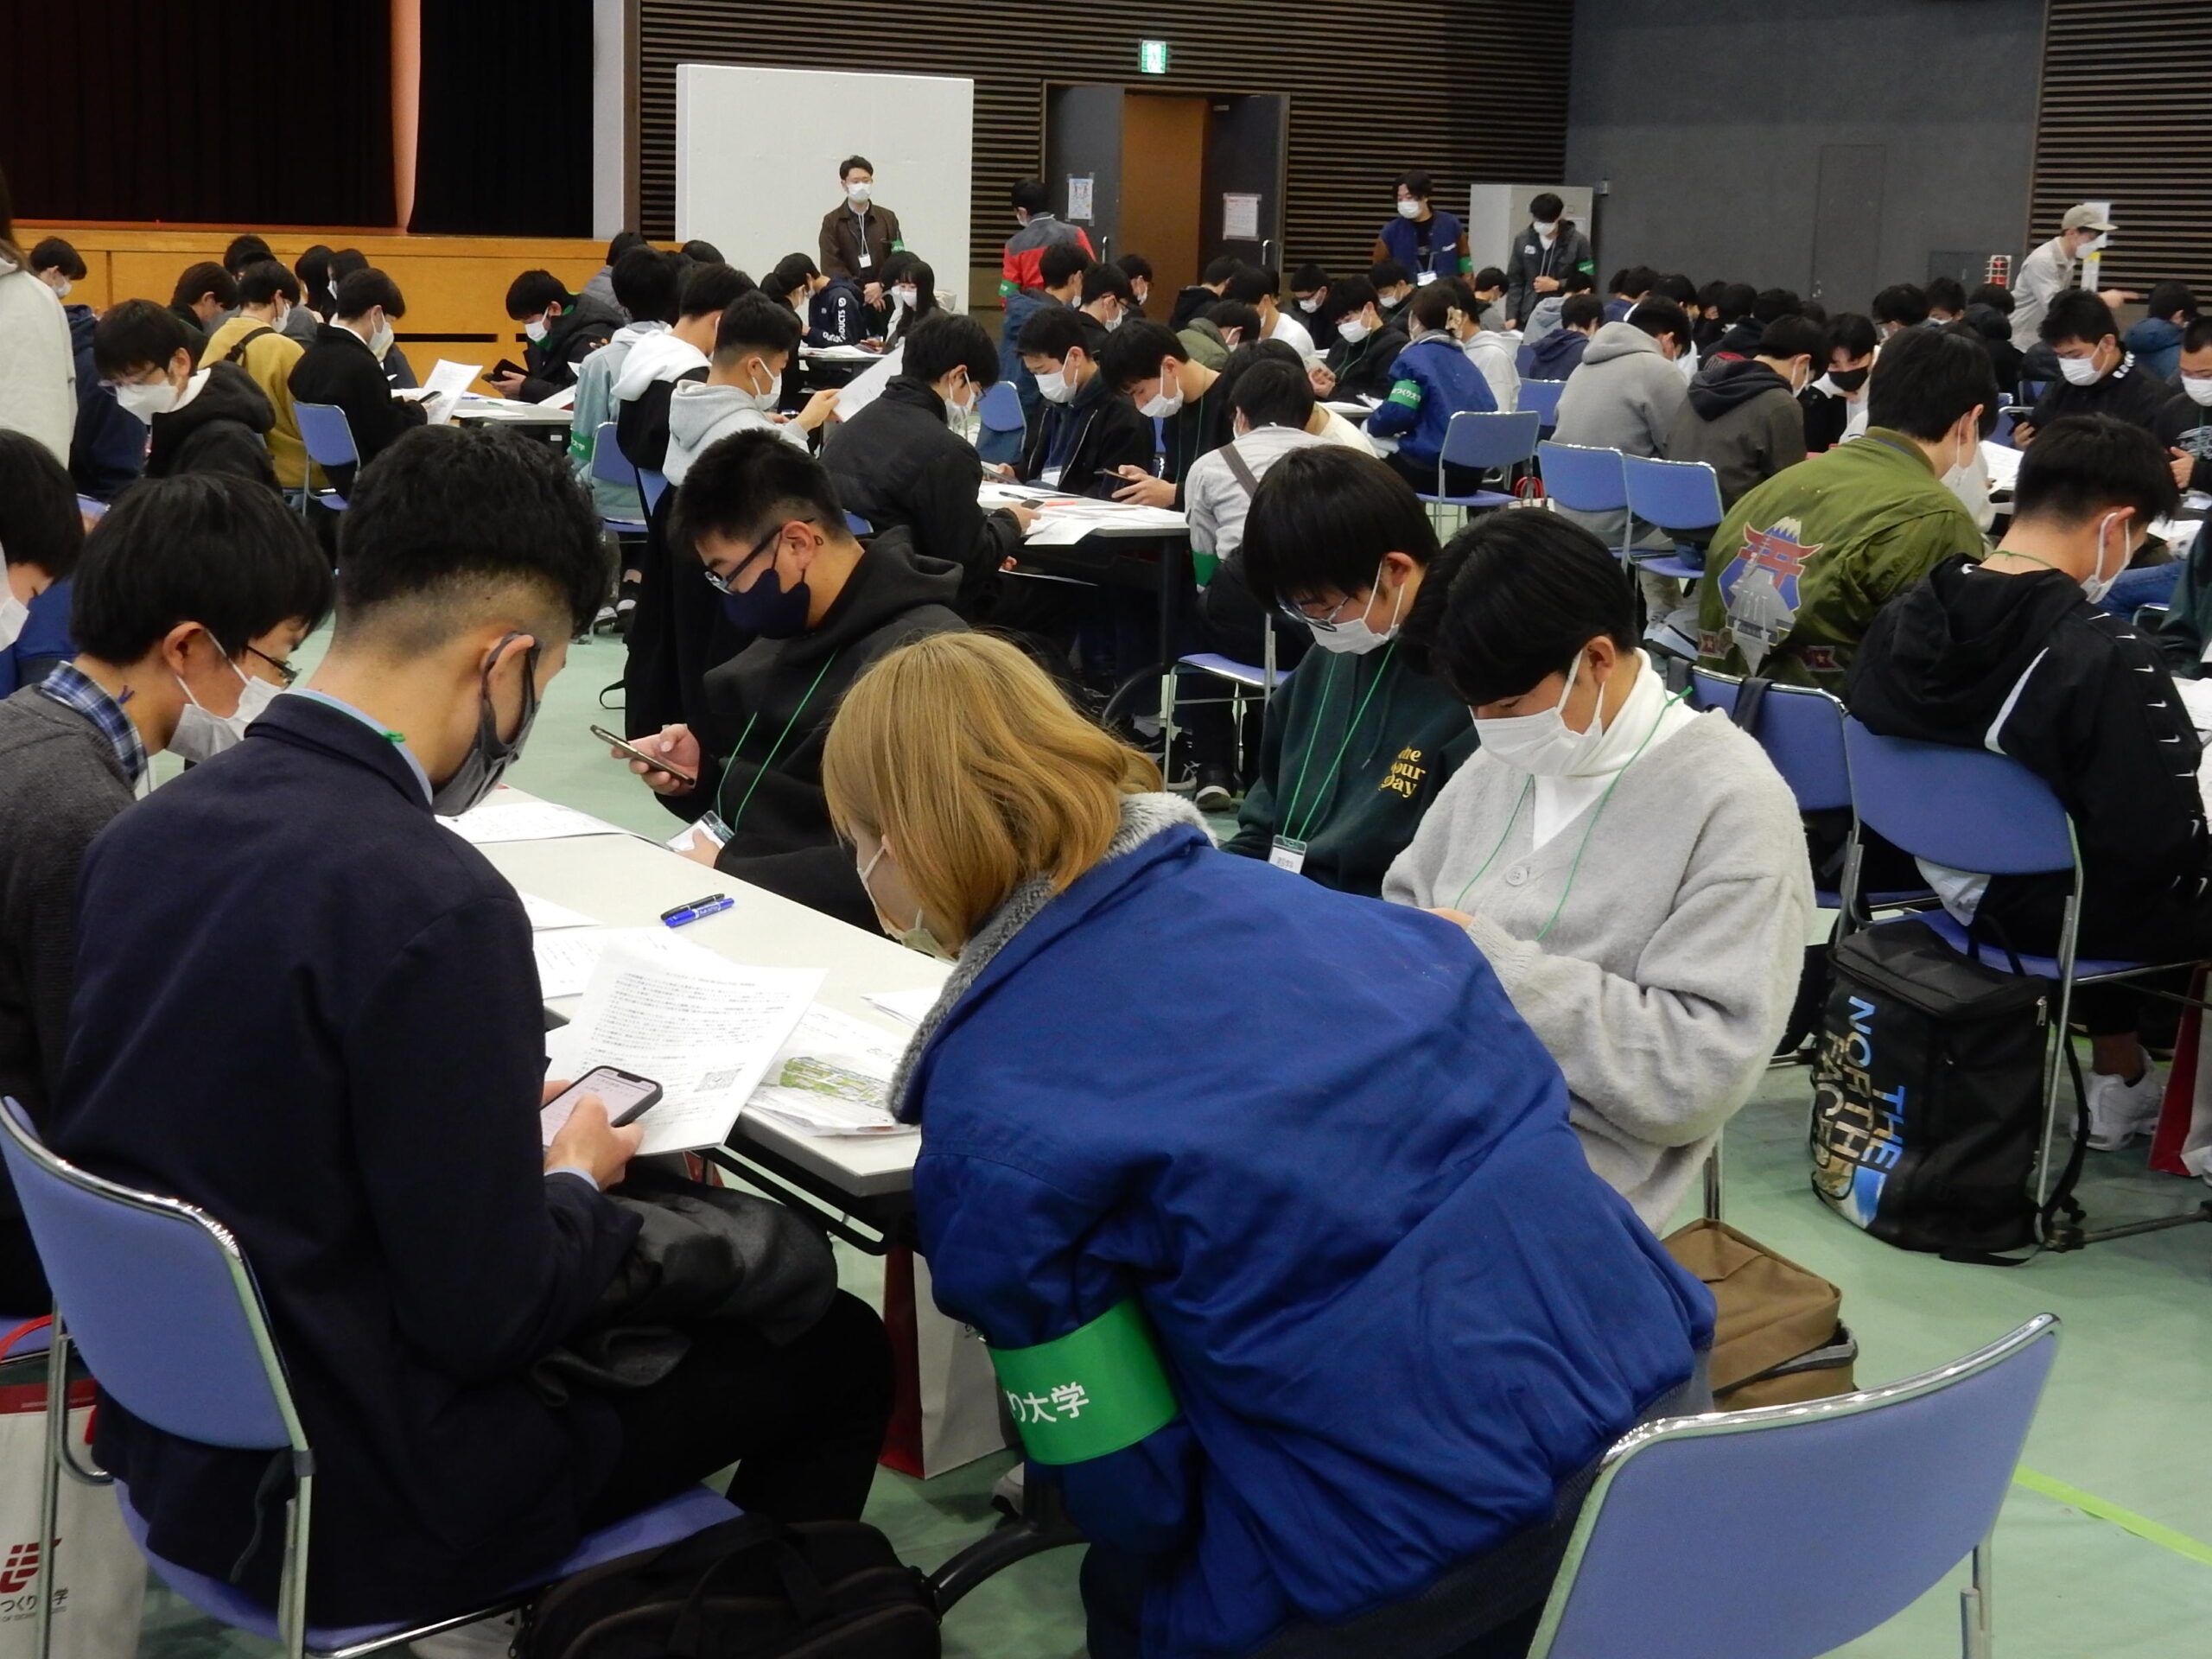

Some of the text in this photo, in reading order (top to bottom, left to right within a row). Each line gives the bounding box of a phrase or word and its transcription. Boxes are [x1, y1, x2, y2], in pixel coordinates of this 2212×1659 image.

[1833, 995, 1876, 1160] NORTH
[1861, 1085, 1905, 1169] THE
[0, 1588, 68, 1612] つくり学
